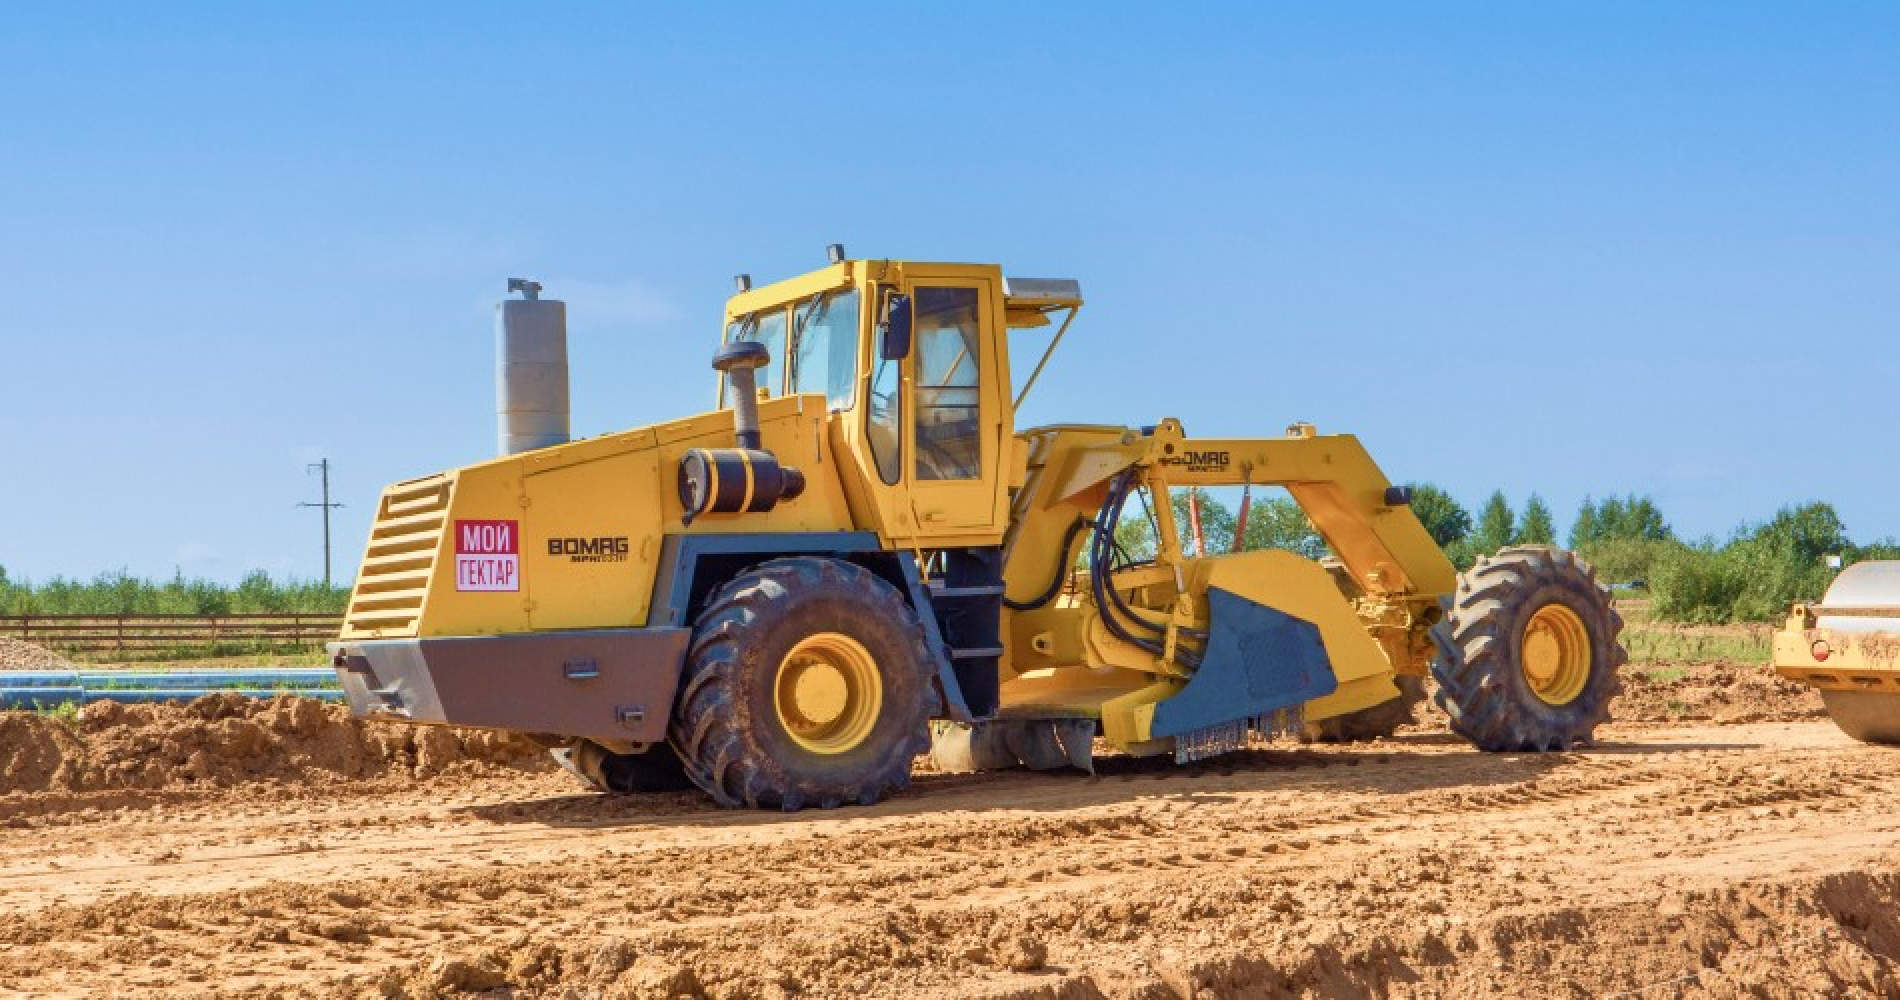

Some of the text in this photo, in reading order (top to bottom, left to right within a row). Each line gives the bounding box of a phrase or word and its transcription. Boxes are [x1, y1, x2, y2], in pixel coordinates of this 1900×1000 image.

[463, 523, 510, 552] МОЙ
[547, 536, 628, 555] BOMAG
[459, 559, 513, 585] ГЕКТАР
